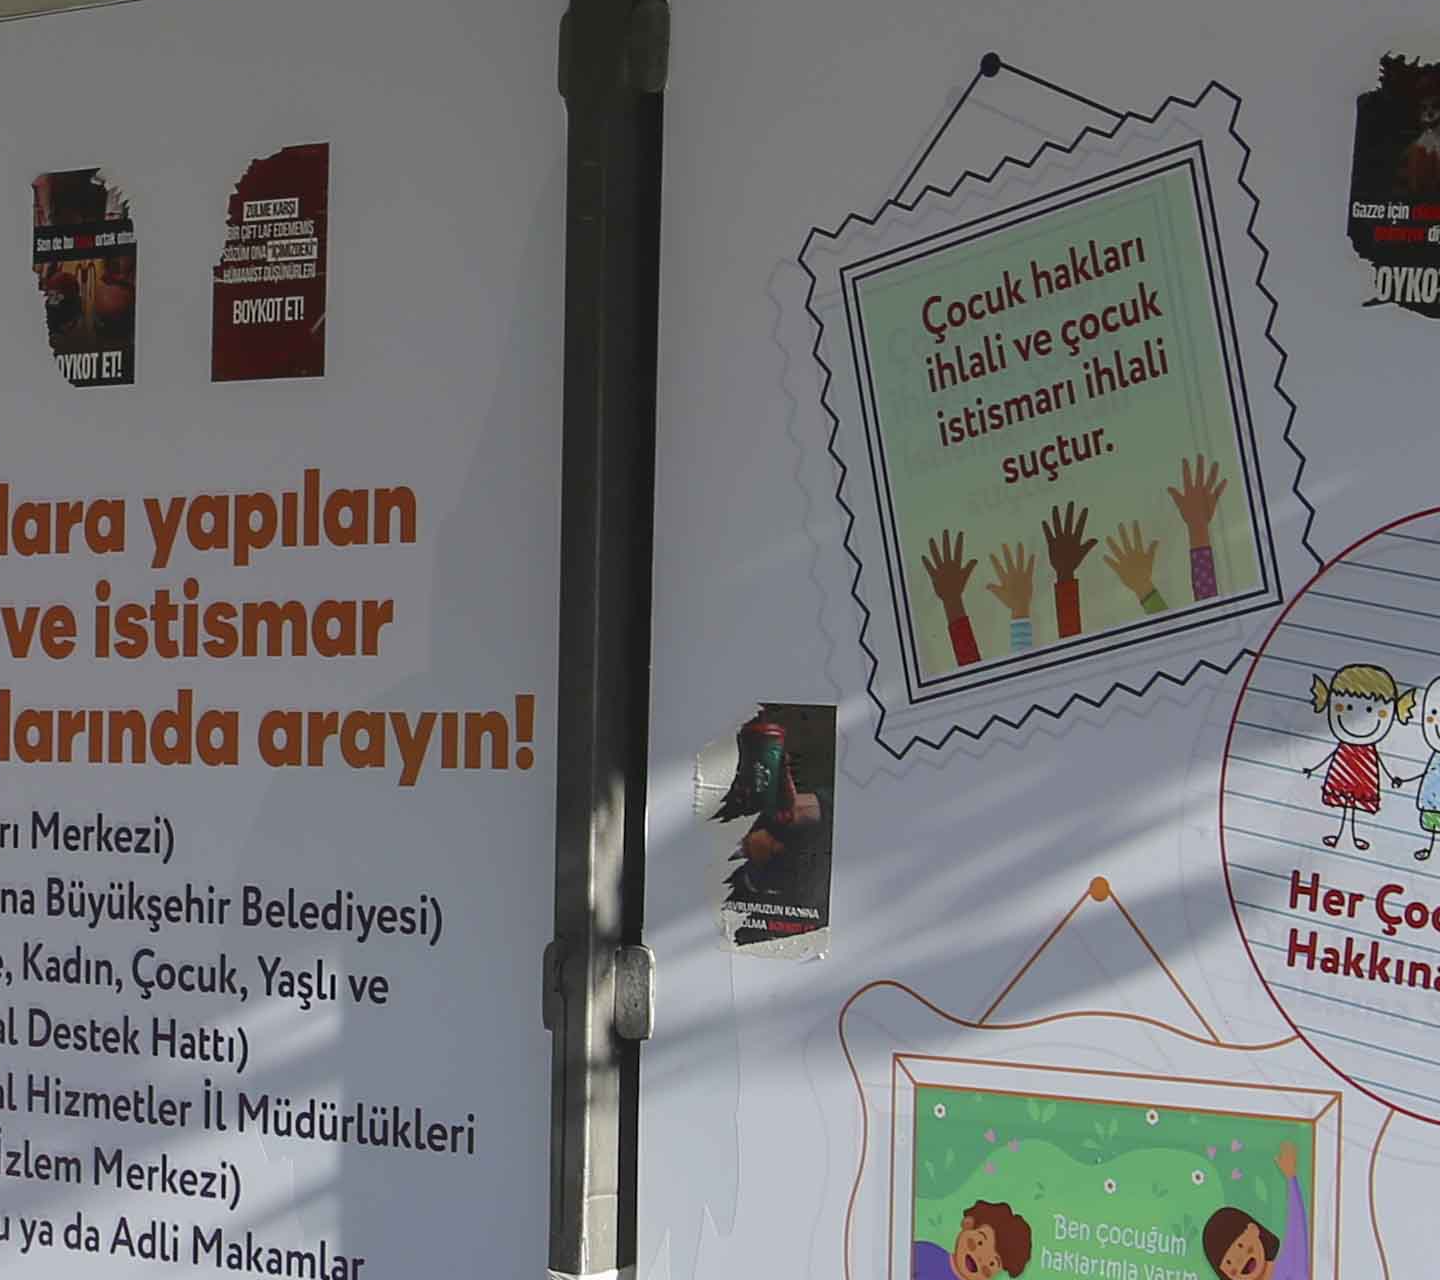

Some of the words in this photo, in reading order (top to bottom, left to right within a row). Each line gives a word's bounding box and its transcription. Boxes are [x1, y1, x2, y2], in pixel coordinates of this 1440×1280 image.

[1352, 201, 1385, 219] Gazze
[1387, 201, 1409, 224] için
[233, 297, 283, 324] BOYKOT
[285, 296, 304, 321] ET!
[922, 271, 1026, 343] Çocuk
[1031, 237, 1146, 299] hakları
[57, 352, 99, 382] OYKOT
[102, 351, 123, 379] ET!
[926, 333, 1007, 393] ihlali
[1013, 329, 1053, 362] ve
[1061, 282, 1162, 356] çocuk
[937, 379, 1076, 447] istismarı
[1083, 337, 1168, 399] ihlali
[1002, 428, 1115, 484] suçtur.
[144, 468, 417, 568] yapılan
[0, 603, 77, 660] ve
[94, 577, 394, 660] istismar
[257, 694, 535, 787] arayın!
[31, 812, 176, 864] Merkezi)
[46, 876, 231, 933] Büyükşehir
[241, 885, 443, 945] Belediyesi)
[1289, 870, 1364, 918] Her
[22, 942, 123, 992] Kadın,
[131, 949, 248, 1001] Çocuk,
[257, 956, 337, 1010] Yaşlı
[348, 974, 389, 1006] ve
[27, 1009, 140, 1056] Destek
[152, 1019, 249, 1074] Hattı)
[26, 1070, 192, 1129] Hizmetler
[203, 1080, 226, 1133] İl
[238, 1094, 476, 1157] Müdürlükleri
[93, 1146, 241, 1211] Merkezi)
[20, 1219, 54, 1253] ya
[63, 1211, 100, 1254] da
[110, 1217, 180, 1265] Adli
[1054, 1214, 1090, 1241] Ben
[1096, 1223, 1187, 1257] çocuğum
